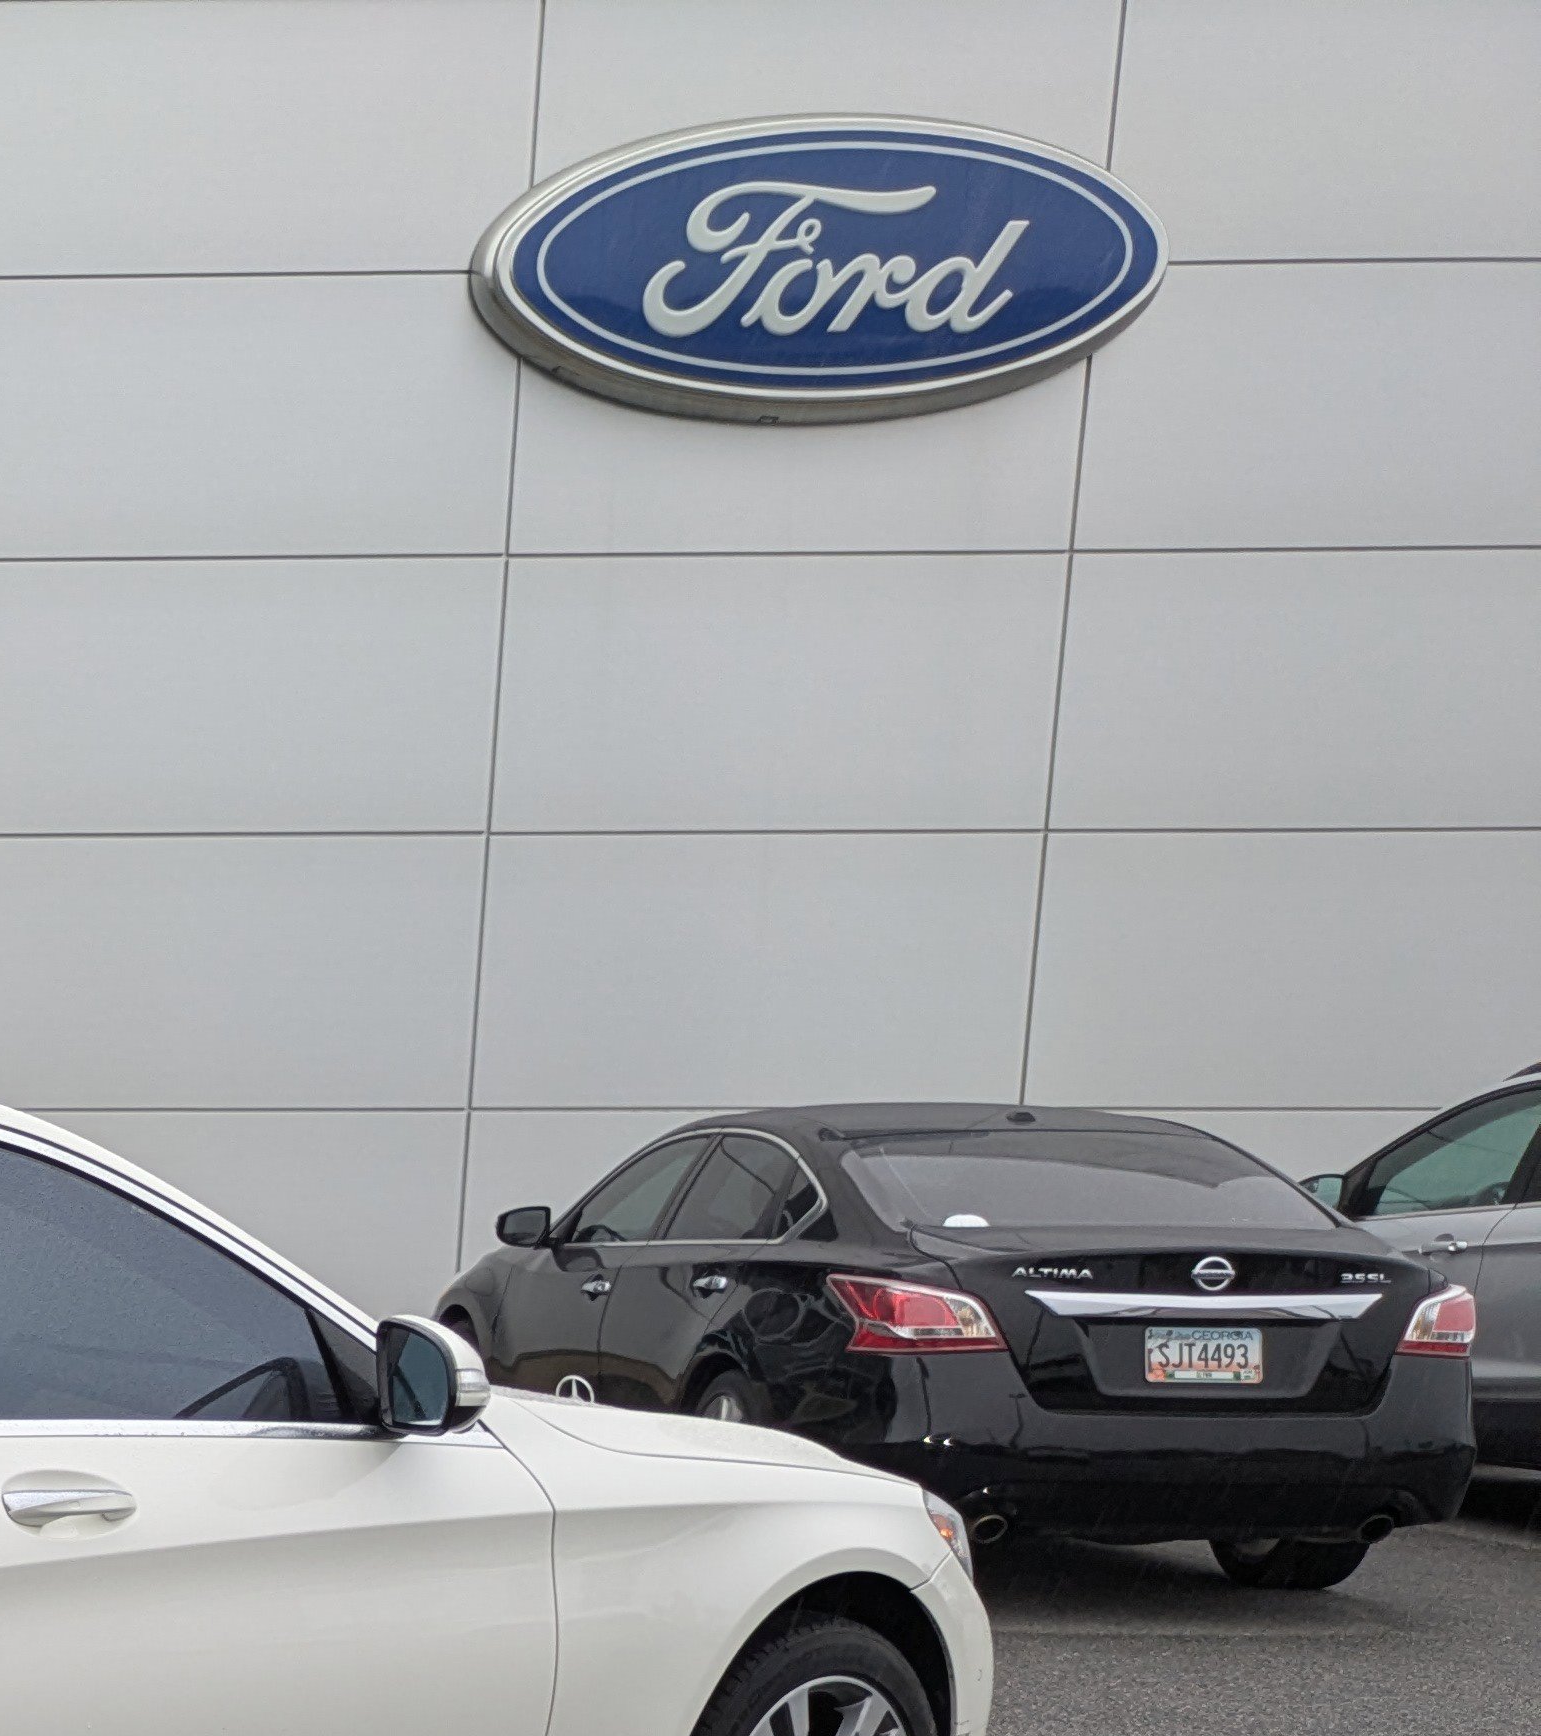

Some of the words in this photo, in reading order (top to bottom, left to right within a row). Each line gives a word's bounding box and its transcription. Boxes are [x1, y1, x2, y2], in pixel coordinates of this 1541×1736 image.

[642, 180, 1031, 337] Ford
[1011, 1266, 1094, 1280] ALTIMA
[1191, 1330, 1254, 1341] GEORGIA
[1156, 1342, 1249, 1369] SJT4493
